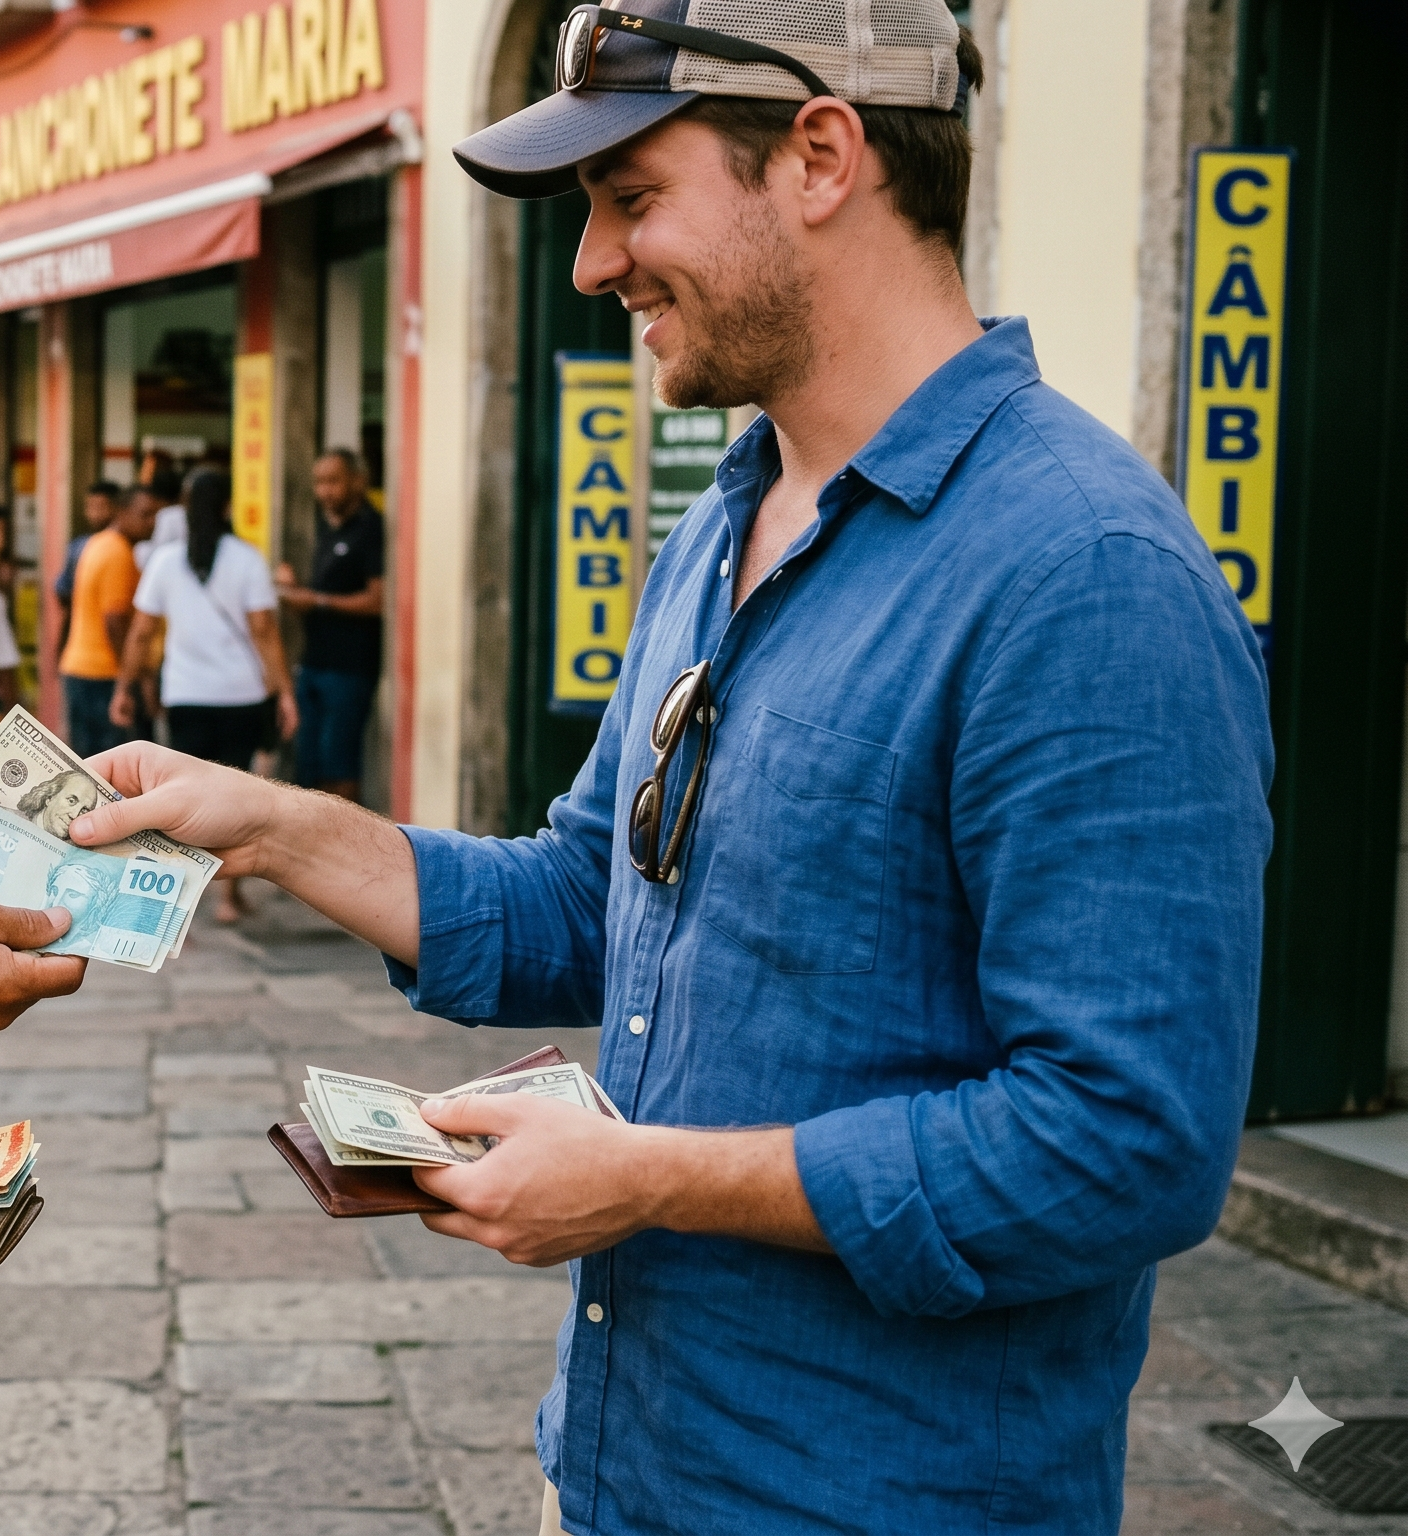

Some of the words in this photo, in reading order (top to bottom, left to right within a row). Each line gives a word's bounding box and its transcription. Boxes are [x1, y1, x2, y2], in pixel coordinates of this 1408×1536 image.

[222, 0, 385, 135] MARIA
[571, 406, 631, 684] CÂMBIO
[129, 868, 176, 897] 100
